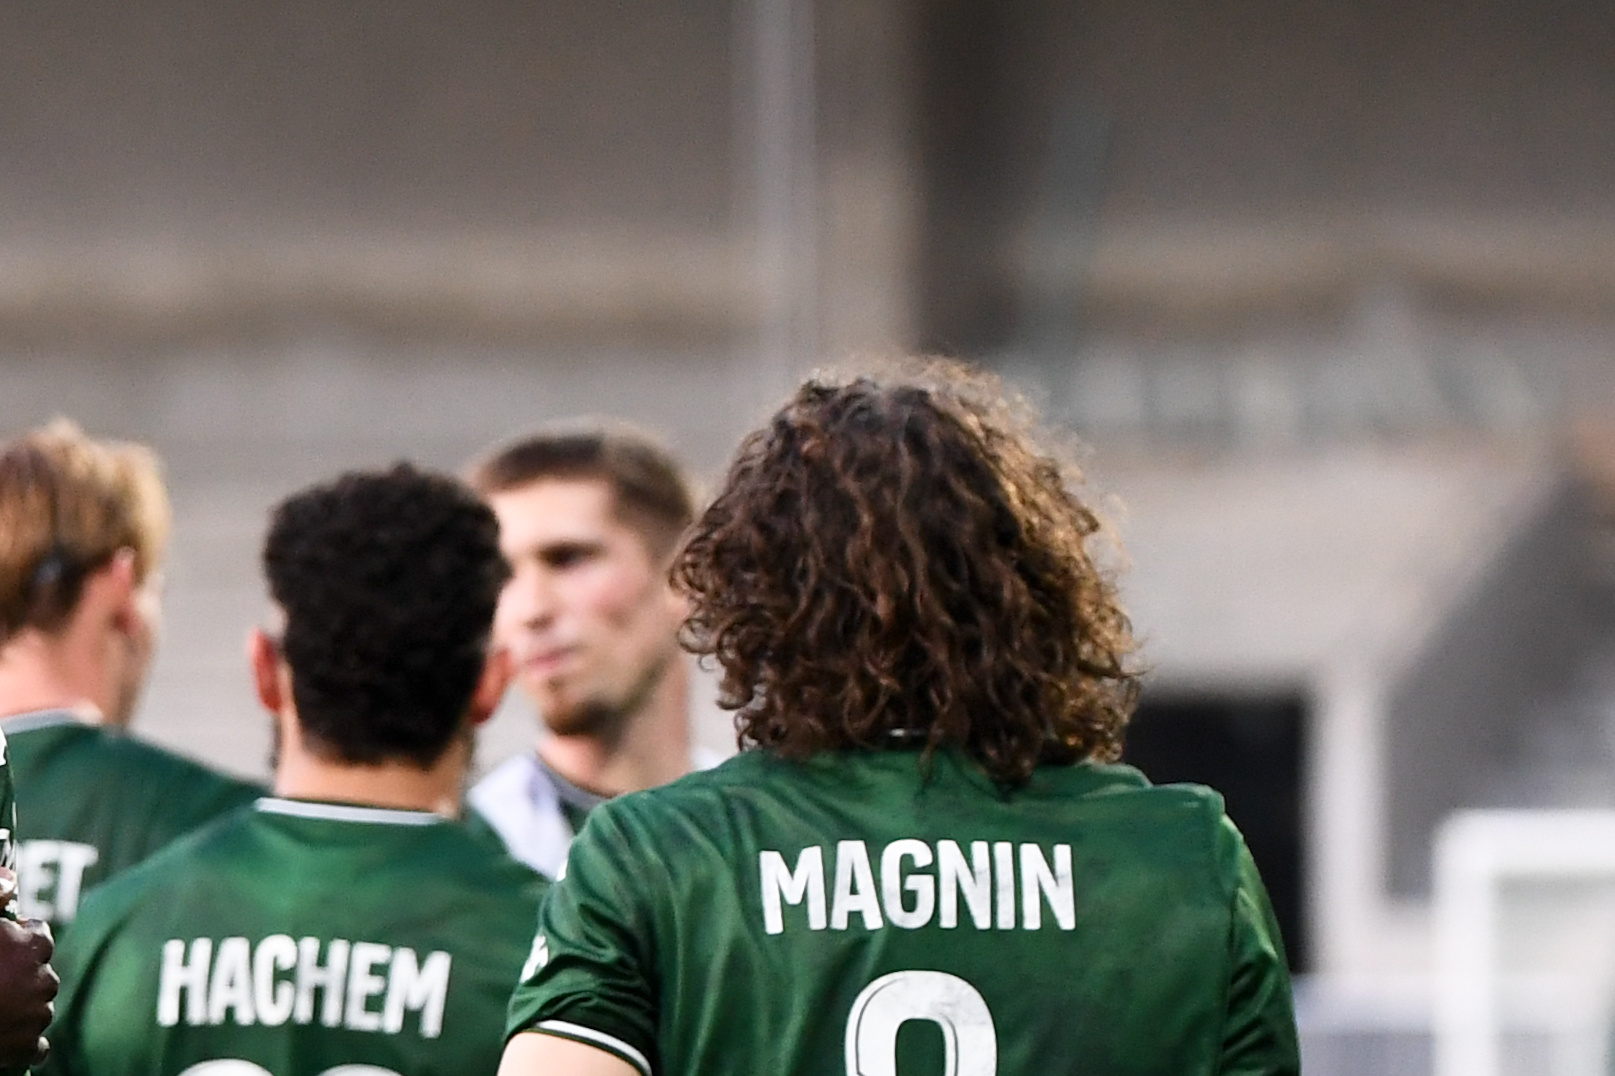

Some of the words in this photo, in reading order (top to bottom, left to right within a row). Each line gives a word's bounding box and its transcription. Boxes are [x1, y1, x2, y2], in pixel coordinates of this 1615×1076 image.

[17, 838, 99, 922] ET
[758, 838, 1076, 935] MAGNIN
[157, 934, 451, 1039] HACHEM
